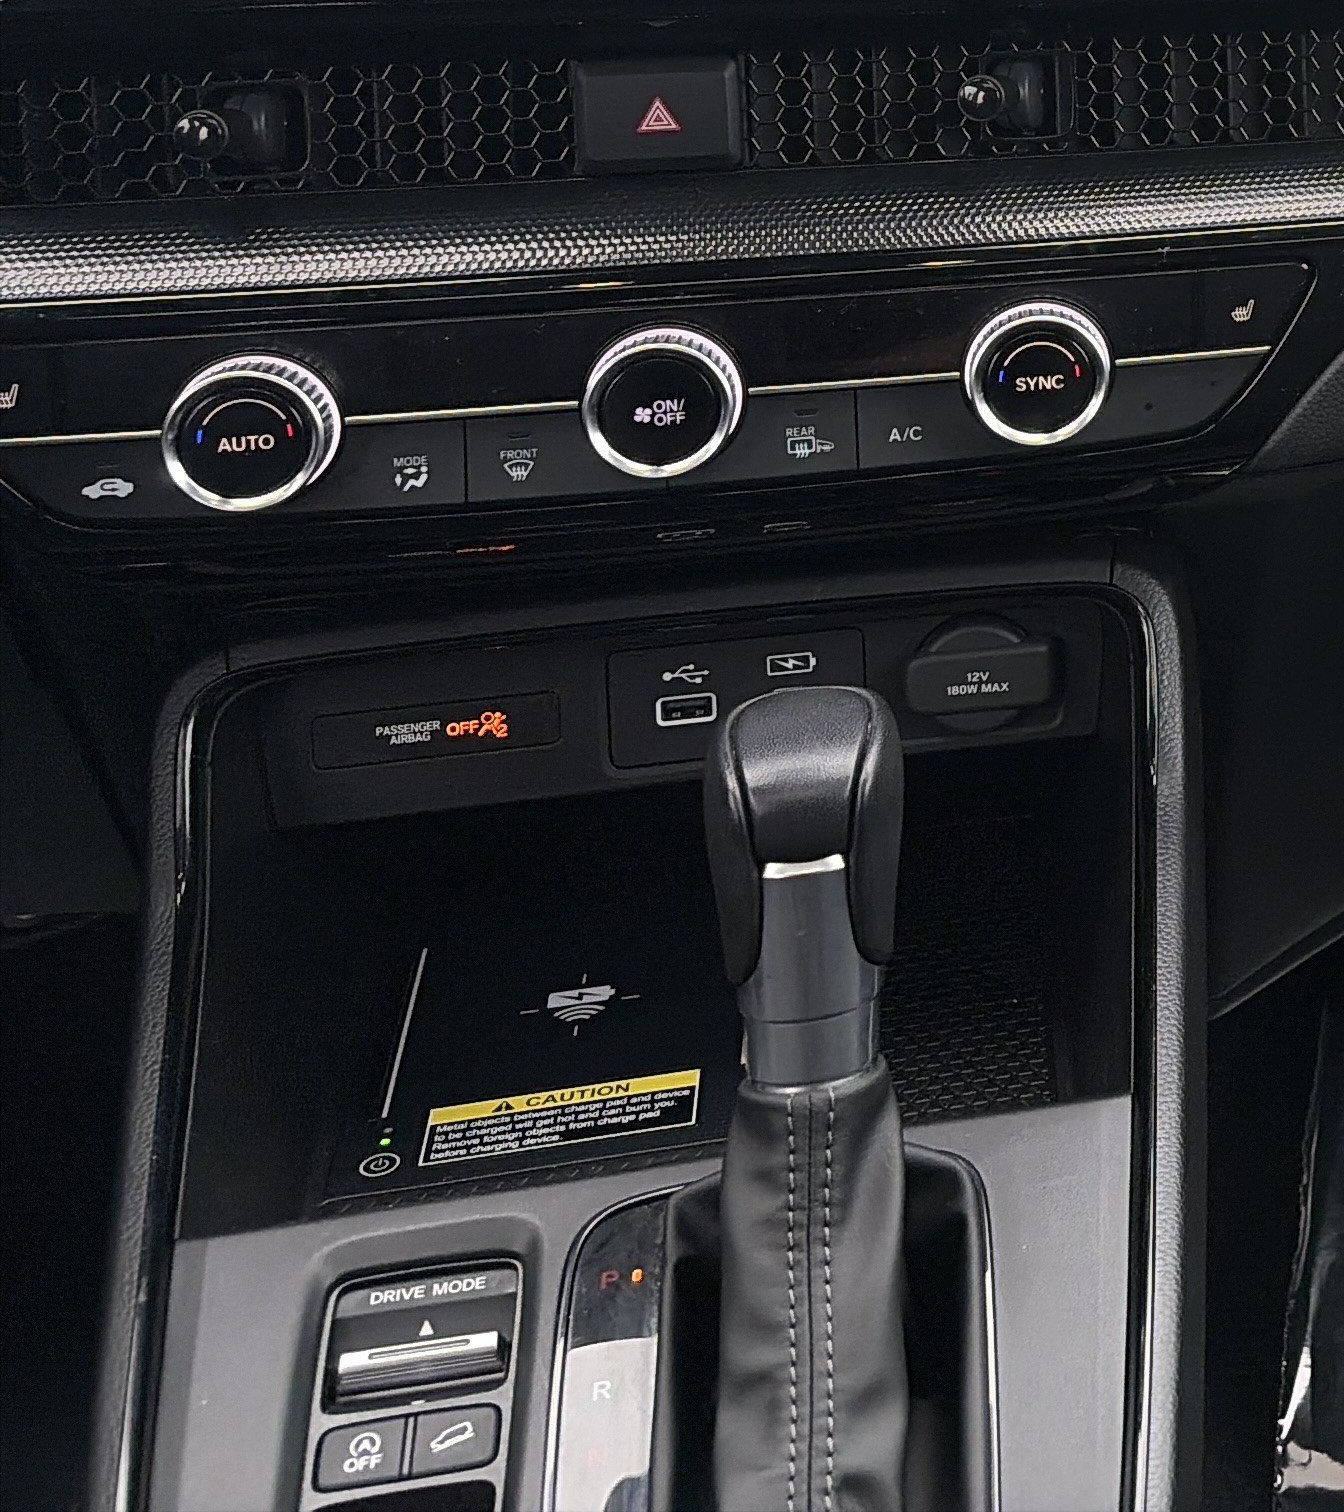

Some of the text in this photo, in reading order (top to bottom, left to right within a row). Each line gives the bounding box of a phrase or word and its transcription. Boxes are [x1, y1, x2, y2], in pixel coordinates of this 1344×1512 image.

[1014, 374, 1065, 392] SYNC
[652, 411, 686, 427] OFF
[785, 426, 815, 438] REAR
[888, 426, 923, 443] A/C
[217, 433, 275, 452] AUTO
[393, 456, 429, 469] MODE
[499, 448, 539, 461] FRONT
[966, 671, 990, 682] 12V
[946, 681, 1009, 697] 180W MAX
[375, 719, 480, 737] PASSENGER OFF
[389, 731, 431, 746] AIRBAG
[525, 1083, 630, 1107] CAUTION
[435, 1089, 691, 1133] Metal objects between charge pad and device
[431, 1110, 661, 1151] Remove foreign objects from charge pad
[434, 1134, 446, 1142] to
[448, 1132, 463, 1141] be
[465, 1123, 513, 1138] charged
[515, 1120, 534, 1129] will
[535, 1117, 554, 1128] get
[556, 1113, 576, 1124] hot
[577, 1110, 600, 1120] and
[601, 1107, 623, 1117] can
[429, 1148, 468, 1161] before
[469, 1140, 520, 1155] charging
[600, 1268, 620, 1291] P
[369, 1276, 488, 1306] DRIVE MODE
[592, 1379, 612, 1402] R
[342, 1453, 385, 1474] OFF
